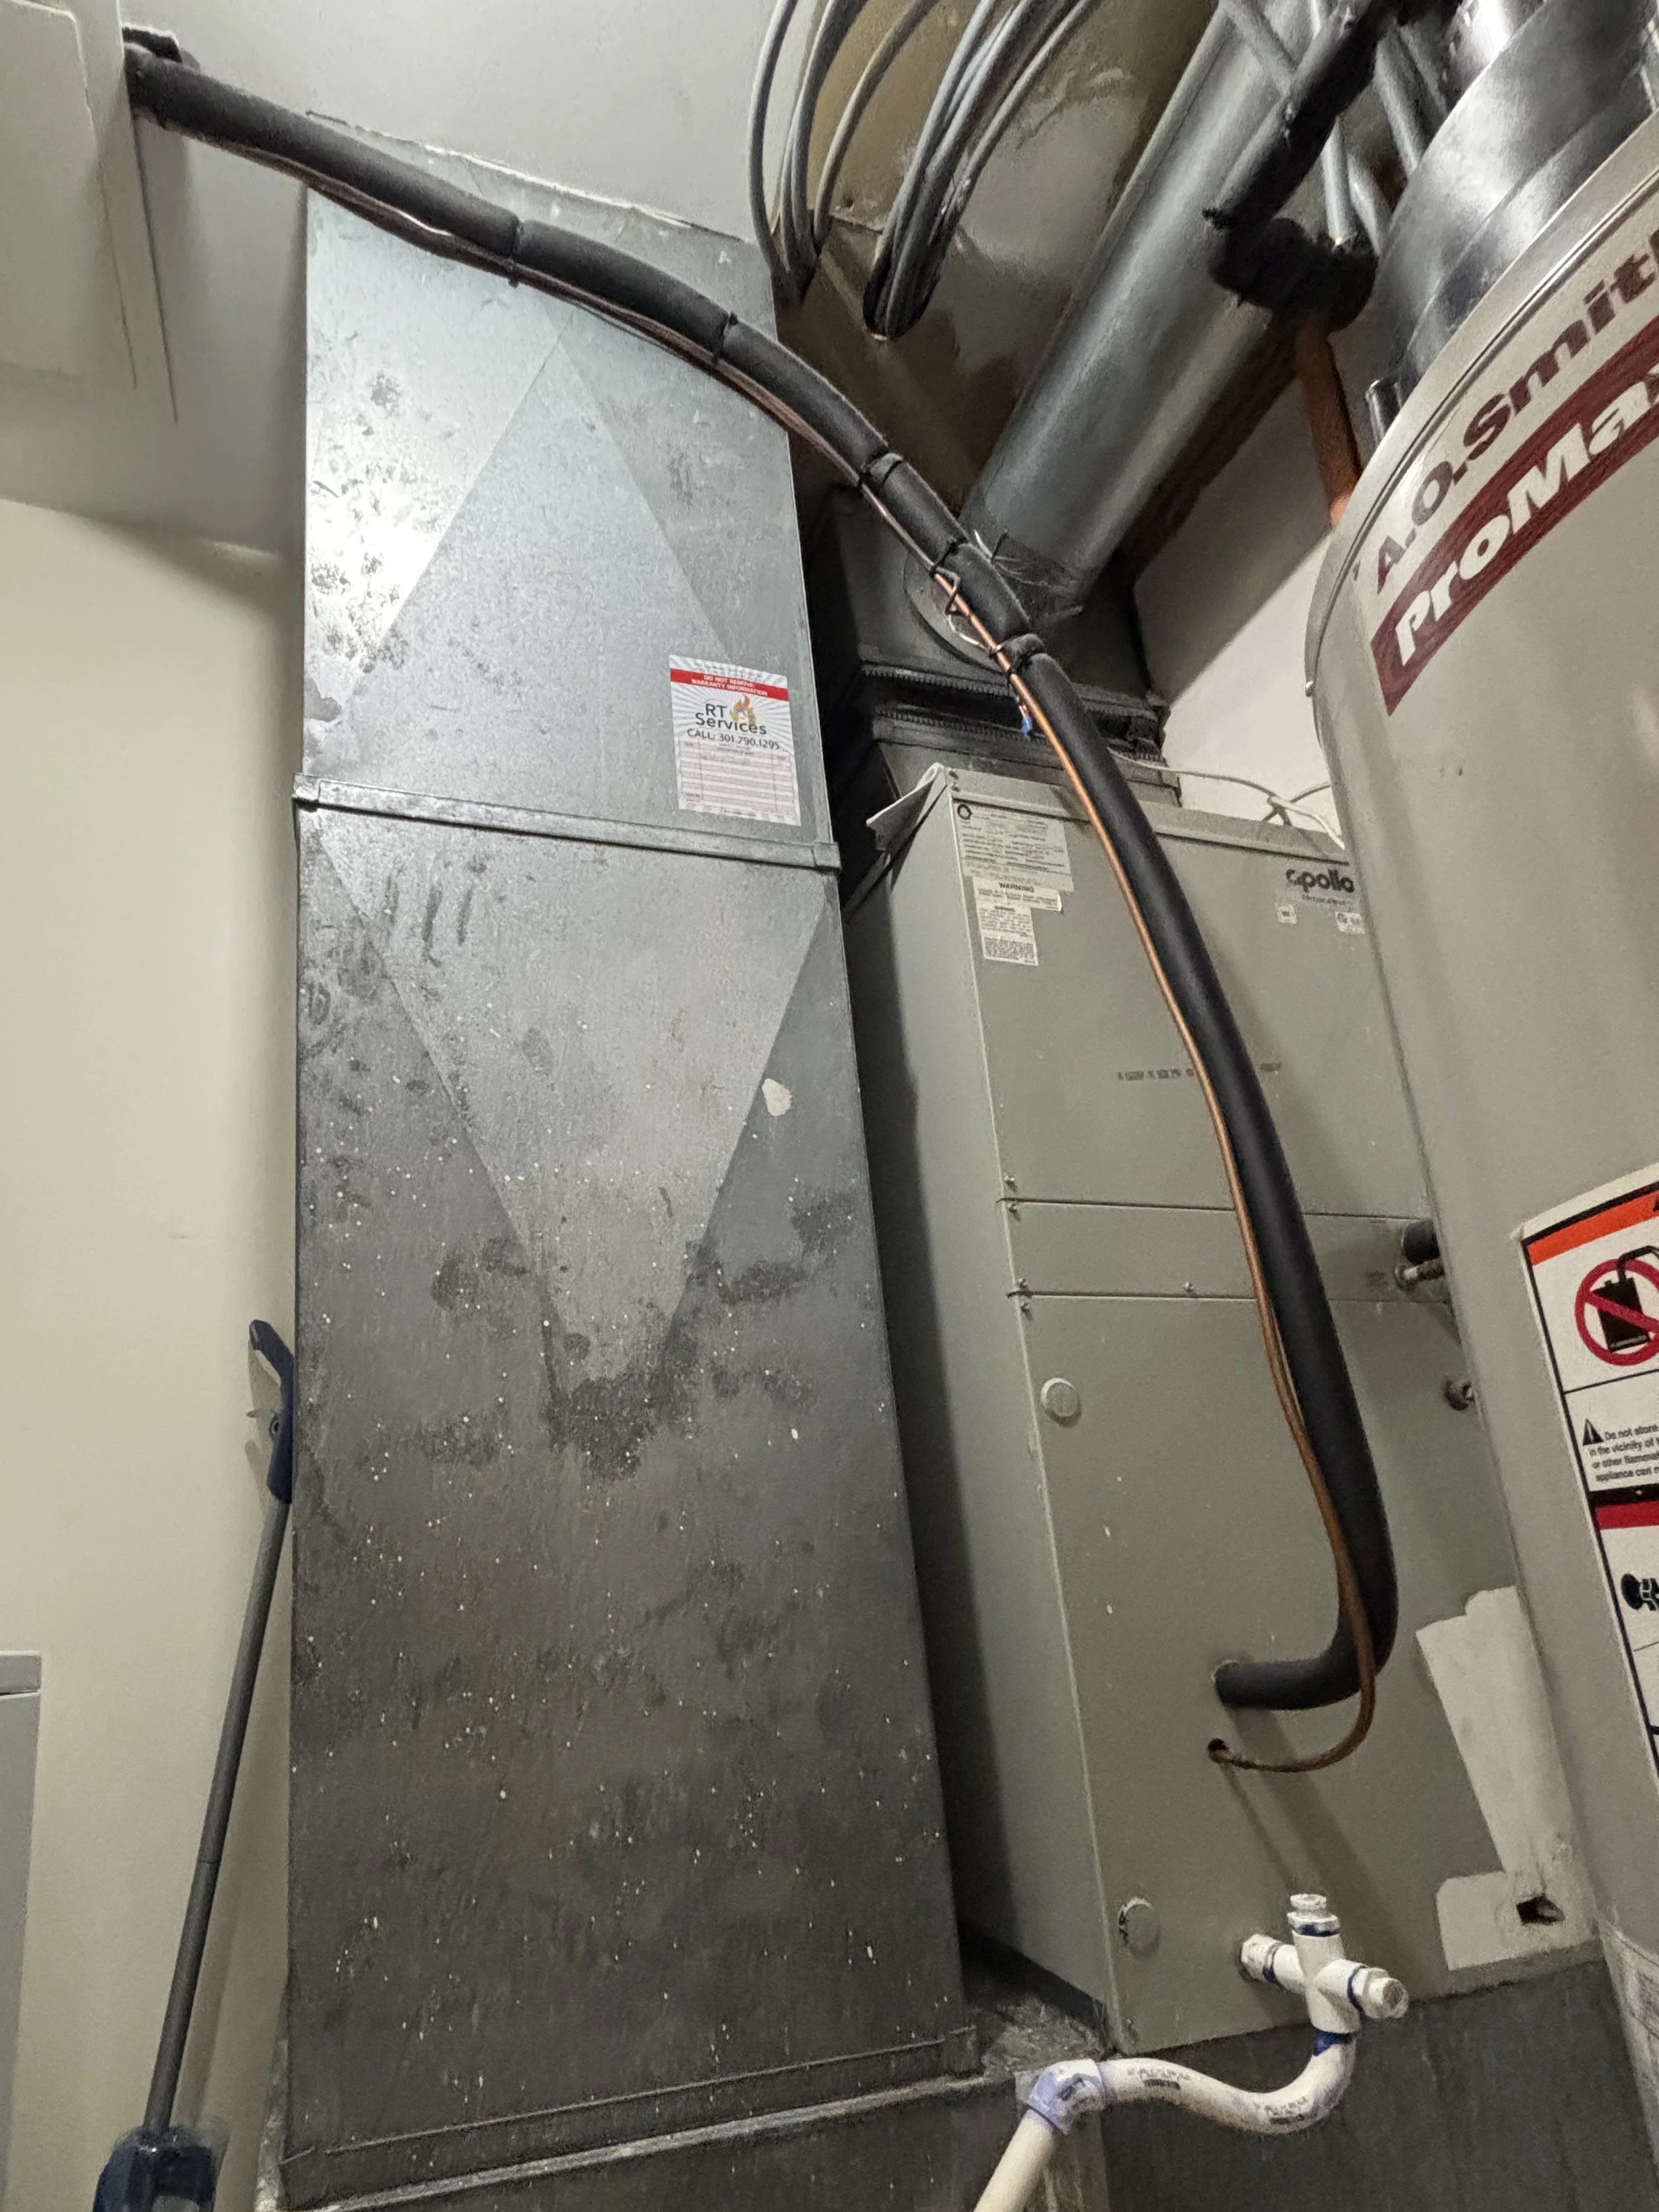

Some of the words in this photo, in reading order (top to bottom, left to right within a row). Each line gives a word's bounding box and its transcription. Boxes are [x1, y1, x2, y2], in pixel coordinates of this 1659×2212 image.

[1395, 363, 1659, 666] ProMa
[715, 676, 728, 684] NOT
[691, 678, 726, 689] WARRANTY
[727, 684, 768, 697] INFORMATION
[705, 704, 727, 718] RT
[695, 712, 767, 735] Services
[998, 882, 1035, 893] WARNING
[1604, 1432, 1617, 1440] Do
[1617, 1427, 1633, 1438] not
[1597, 1446, 1610, 1456] the
[1611, 1441, 1641, 1452] vicinity
[1644, 1438, 1654, 1448] of
[1592, 1461, 1600, 1469] or
[1602, 1458, 1622, 1468] other
[1635, 1467, 1652, 1476] can
